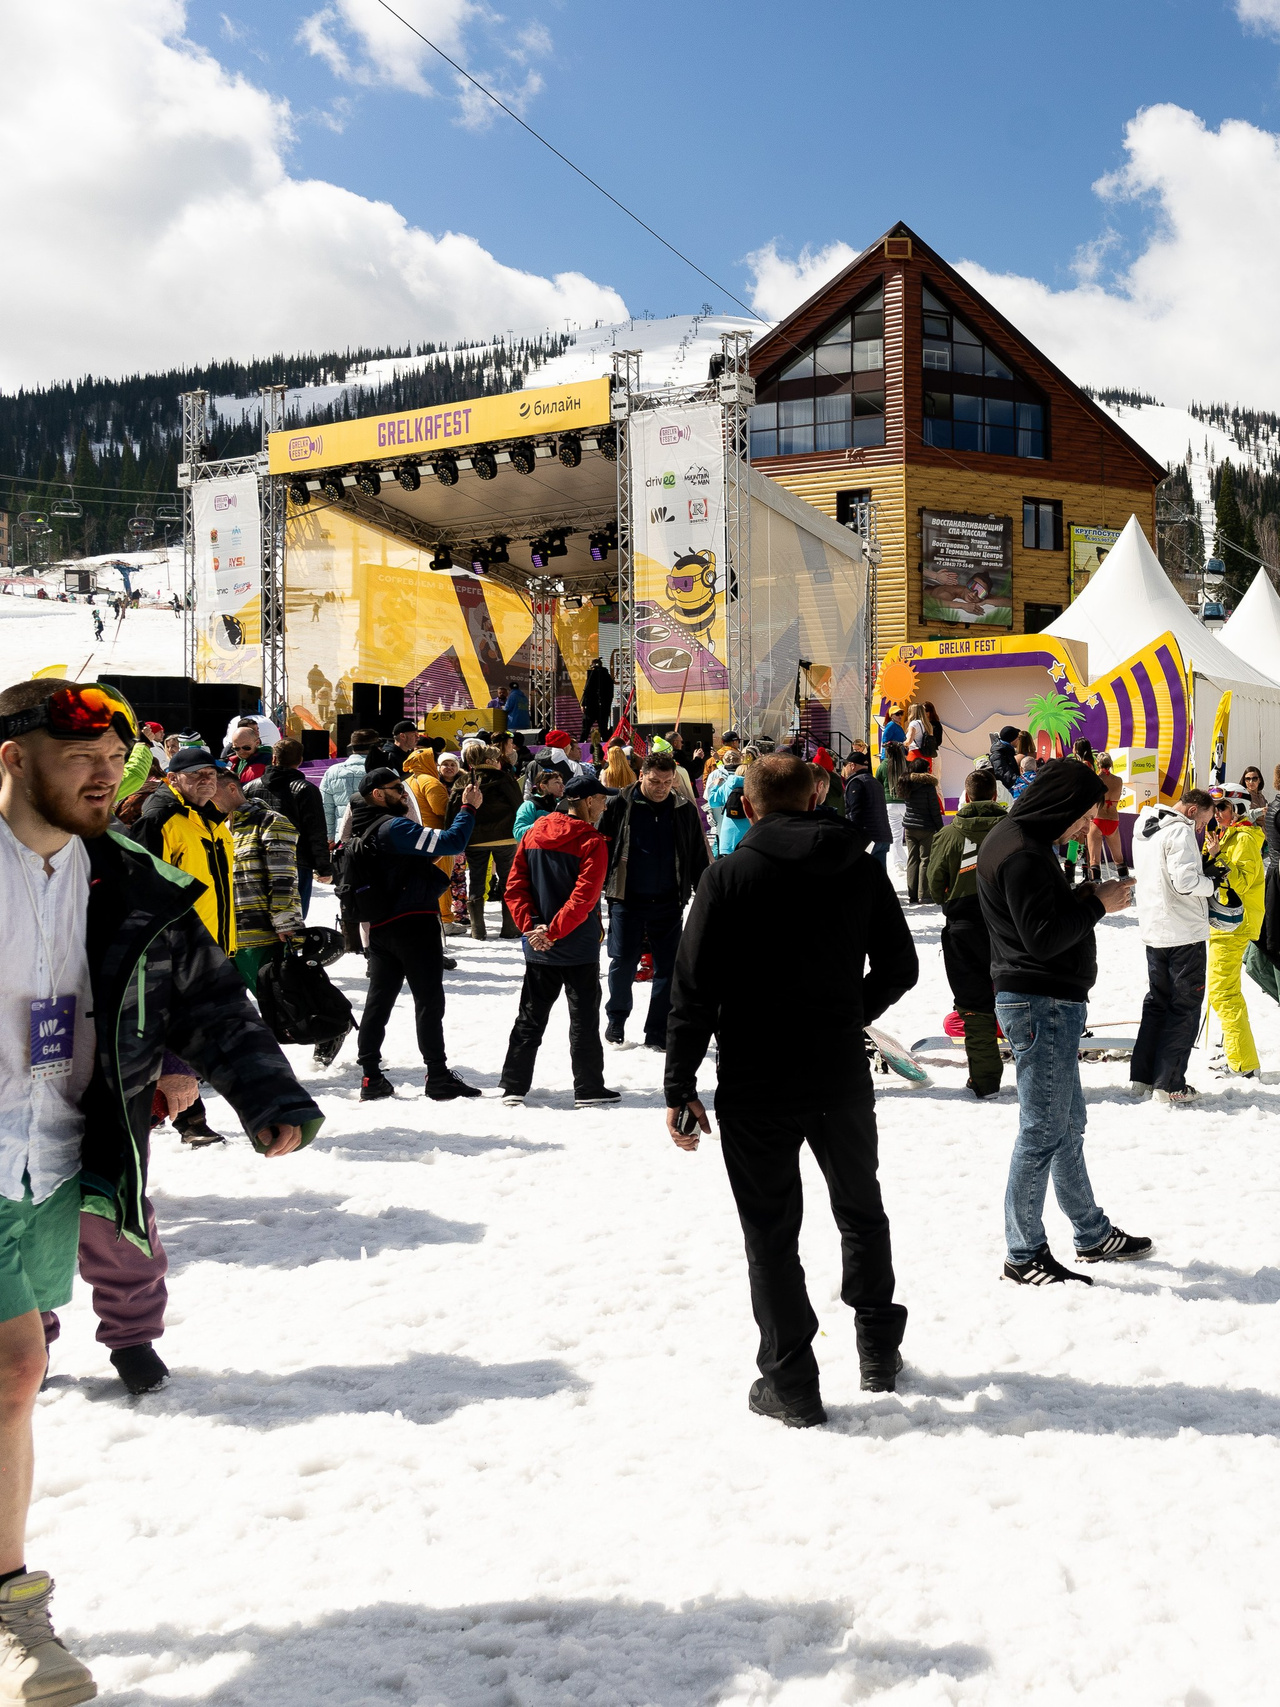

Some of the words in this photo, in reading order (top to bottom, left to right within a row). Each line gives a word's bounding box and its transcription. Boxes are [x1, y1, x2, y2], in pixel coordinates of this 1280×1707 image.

[534, 396, 581, 416] билайн
[377, 408, 472, 448] GRELKAFEST
[291, 439, 309, 449] GRELKA
[292, 449, 304, 458] FEST
[645, 474, 676, 487] drivee
[931, 518, 1004, 532] ВОССТАНАВЛИВАЮЩИЙ
[948, 528, 988, 538] СПА-МАССАЖ
[931, 540, 970, 550] Восстановись
[945, 548, 981, 558] Термальном
[939, 641, 970, 655] GRELKA
[974, 639, 996, 652] FEST
[42, 1043, 61, 1056] 644
